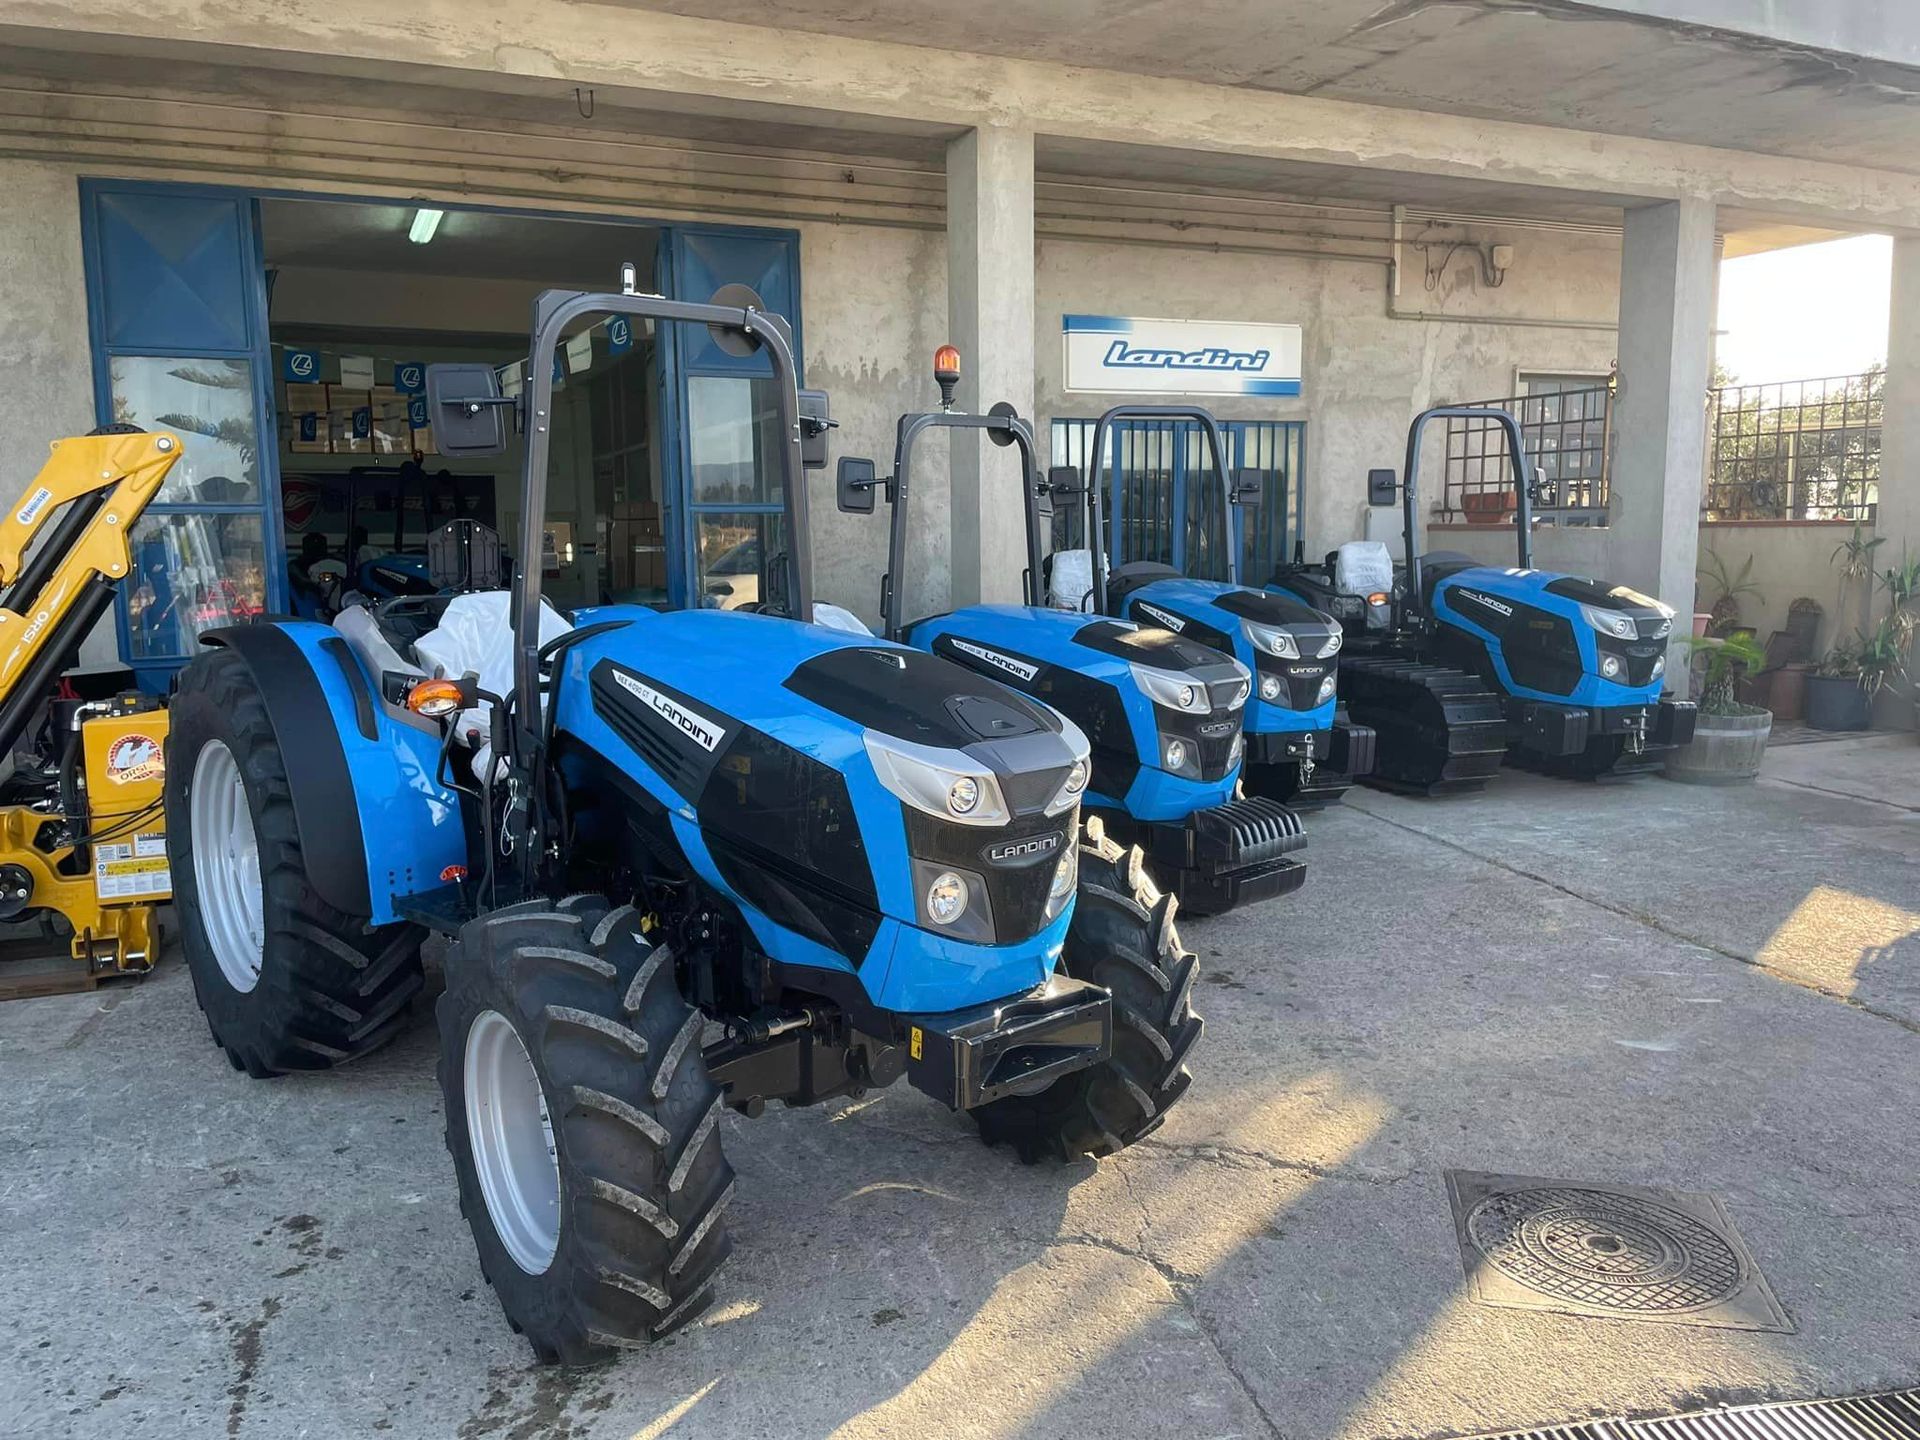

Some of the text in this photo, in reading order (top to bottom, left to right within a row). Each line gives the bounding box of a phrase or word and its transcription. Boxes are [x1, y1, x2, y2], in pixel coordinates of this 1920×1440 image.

[1103, 340, 1270, 371] Landini
[22, 611, 49, 644] ORSI
[985, 652, 1031, 679] LANDINI
[653, 695, 713, 747] LANDINI
[120, 764, 147, 780] ORSI
[991, 837, 1057, 860] LANDINI
